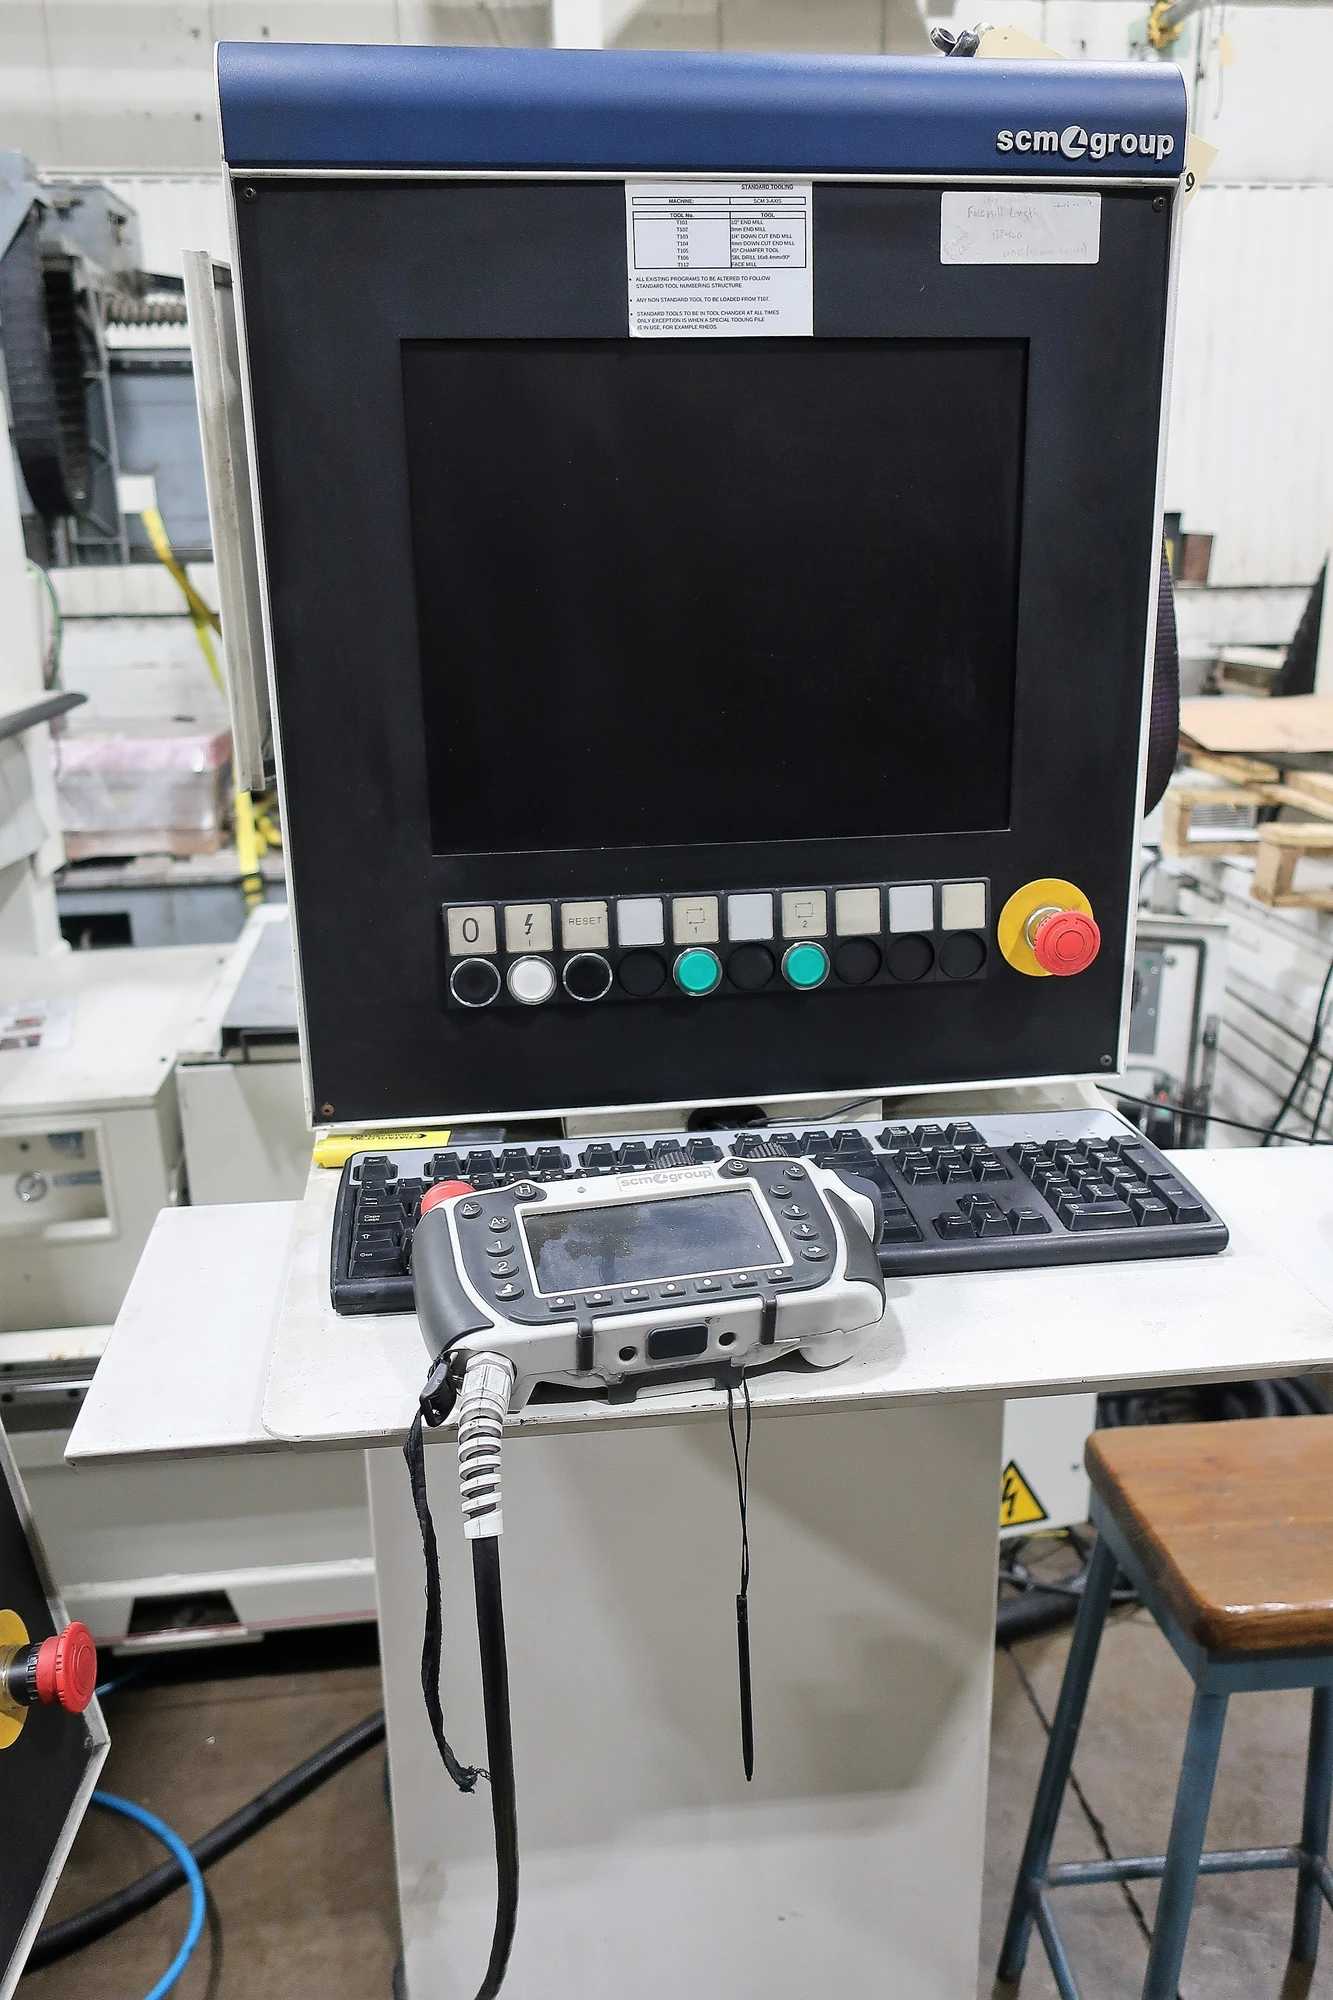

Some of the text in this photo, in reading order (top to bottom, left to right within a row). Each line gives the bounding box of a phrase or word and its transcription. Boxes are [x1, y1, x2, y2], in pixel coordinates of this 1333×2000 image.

[568, 916, 603, 926] RESET
[801, 921, 808, 929] 2
[733, 1161, 744, 1169] S
[520, 1185, 532, 1194] H
[491, 1217, 508, 1226] A+
[494, 1241, 503, 1250] 1
[498, 1261, 509, 1272] 2
